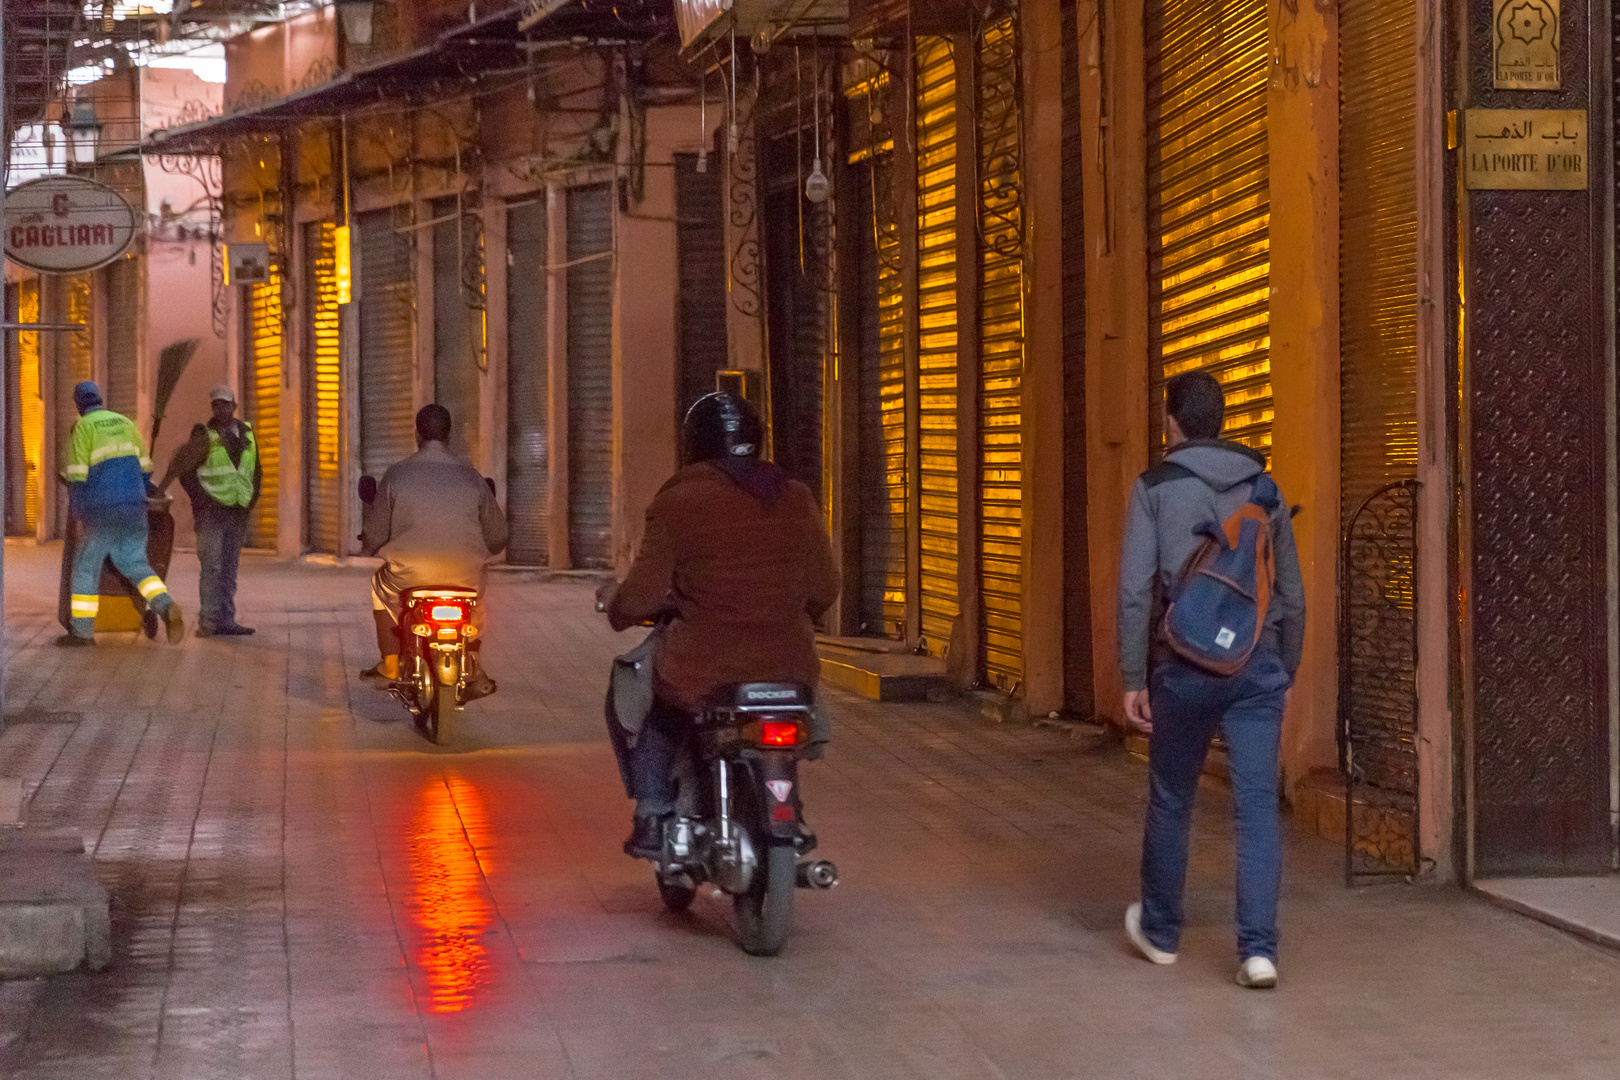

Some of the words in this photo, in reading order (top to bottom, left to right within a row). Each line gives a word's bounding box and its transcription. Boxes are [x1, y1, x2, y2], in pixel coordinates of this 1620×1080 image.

[1510, 71, 1533, 81] PORTE
[1475, 120, 1533, 143] الذهب
[1541, 121, 1579, 145] باب
[1472, 153, 1489, 172] LA
[1493, 153, 1539, 172] PORTE
[1546, 153, 1583, 173] D'OR
[10, 223, 114, 249] CAGLIARI
